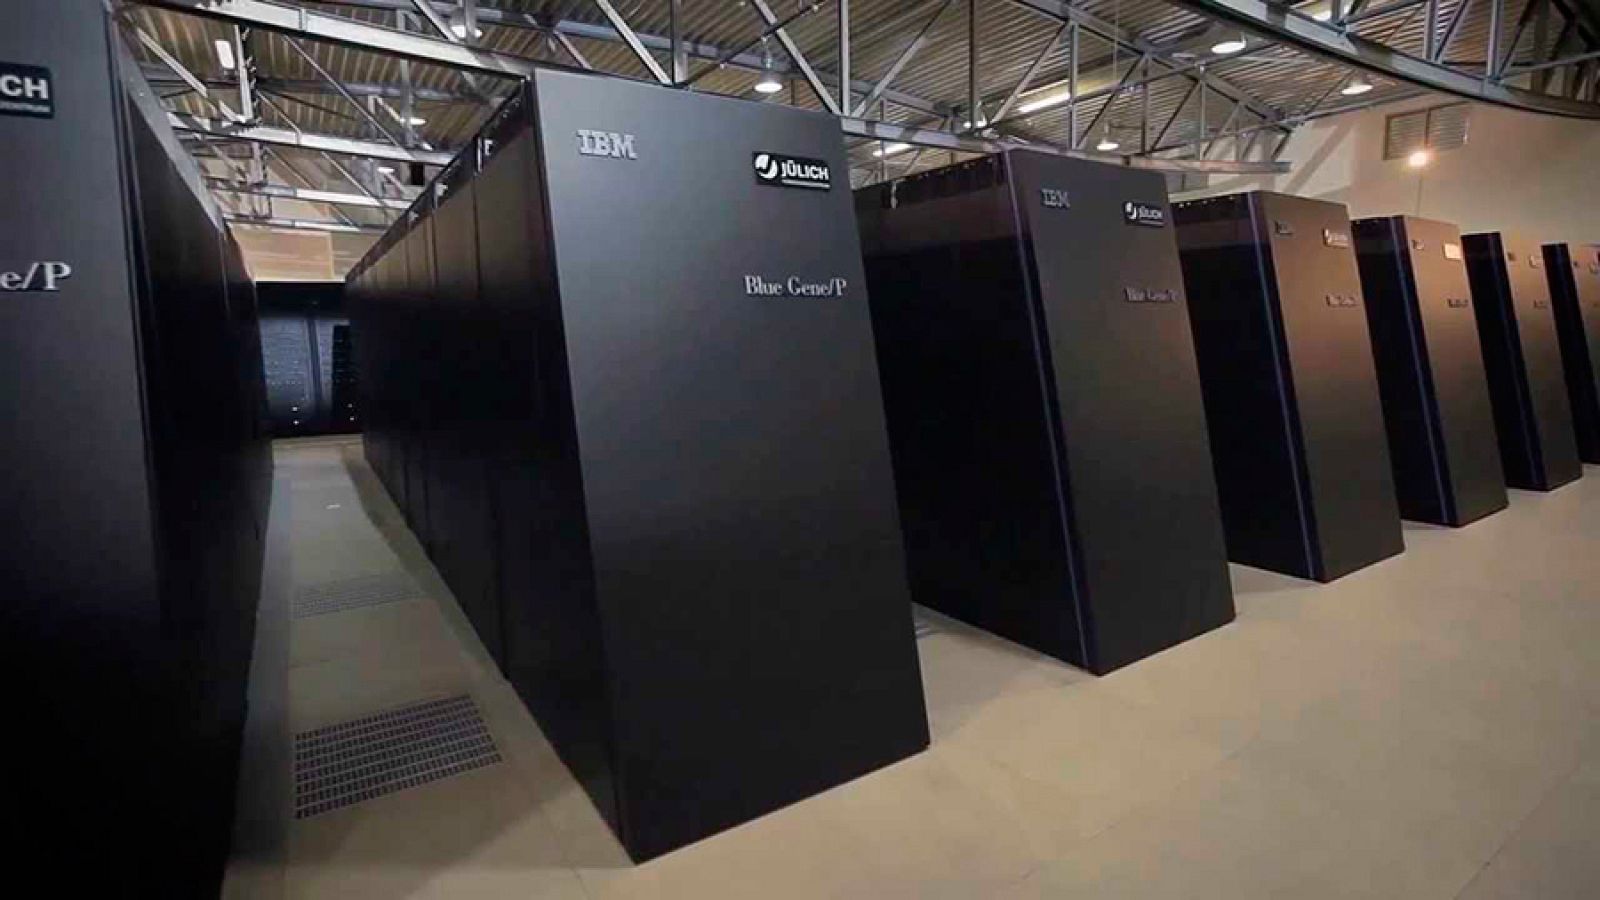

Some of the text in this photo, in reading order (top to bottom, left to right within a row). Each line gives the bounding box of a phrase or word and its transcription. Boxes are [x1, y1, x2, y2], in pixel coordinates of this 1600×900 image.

[578, 129, 637, 160] IBM
[781, 160, 829, 180] JÜLICH
[745, 275, 847, 298] Blue Gene/P
